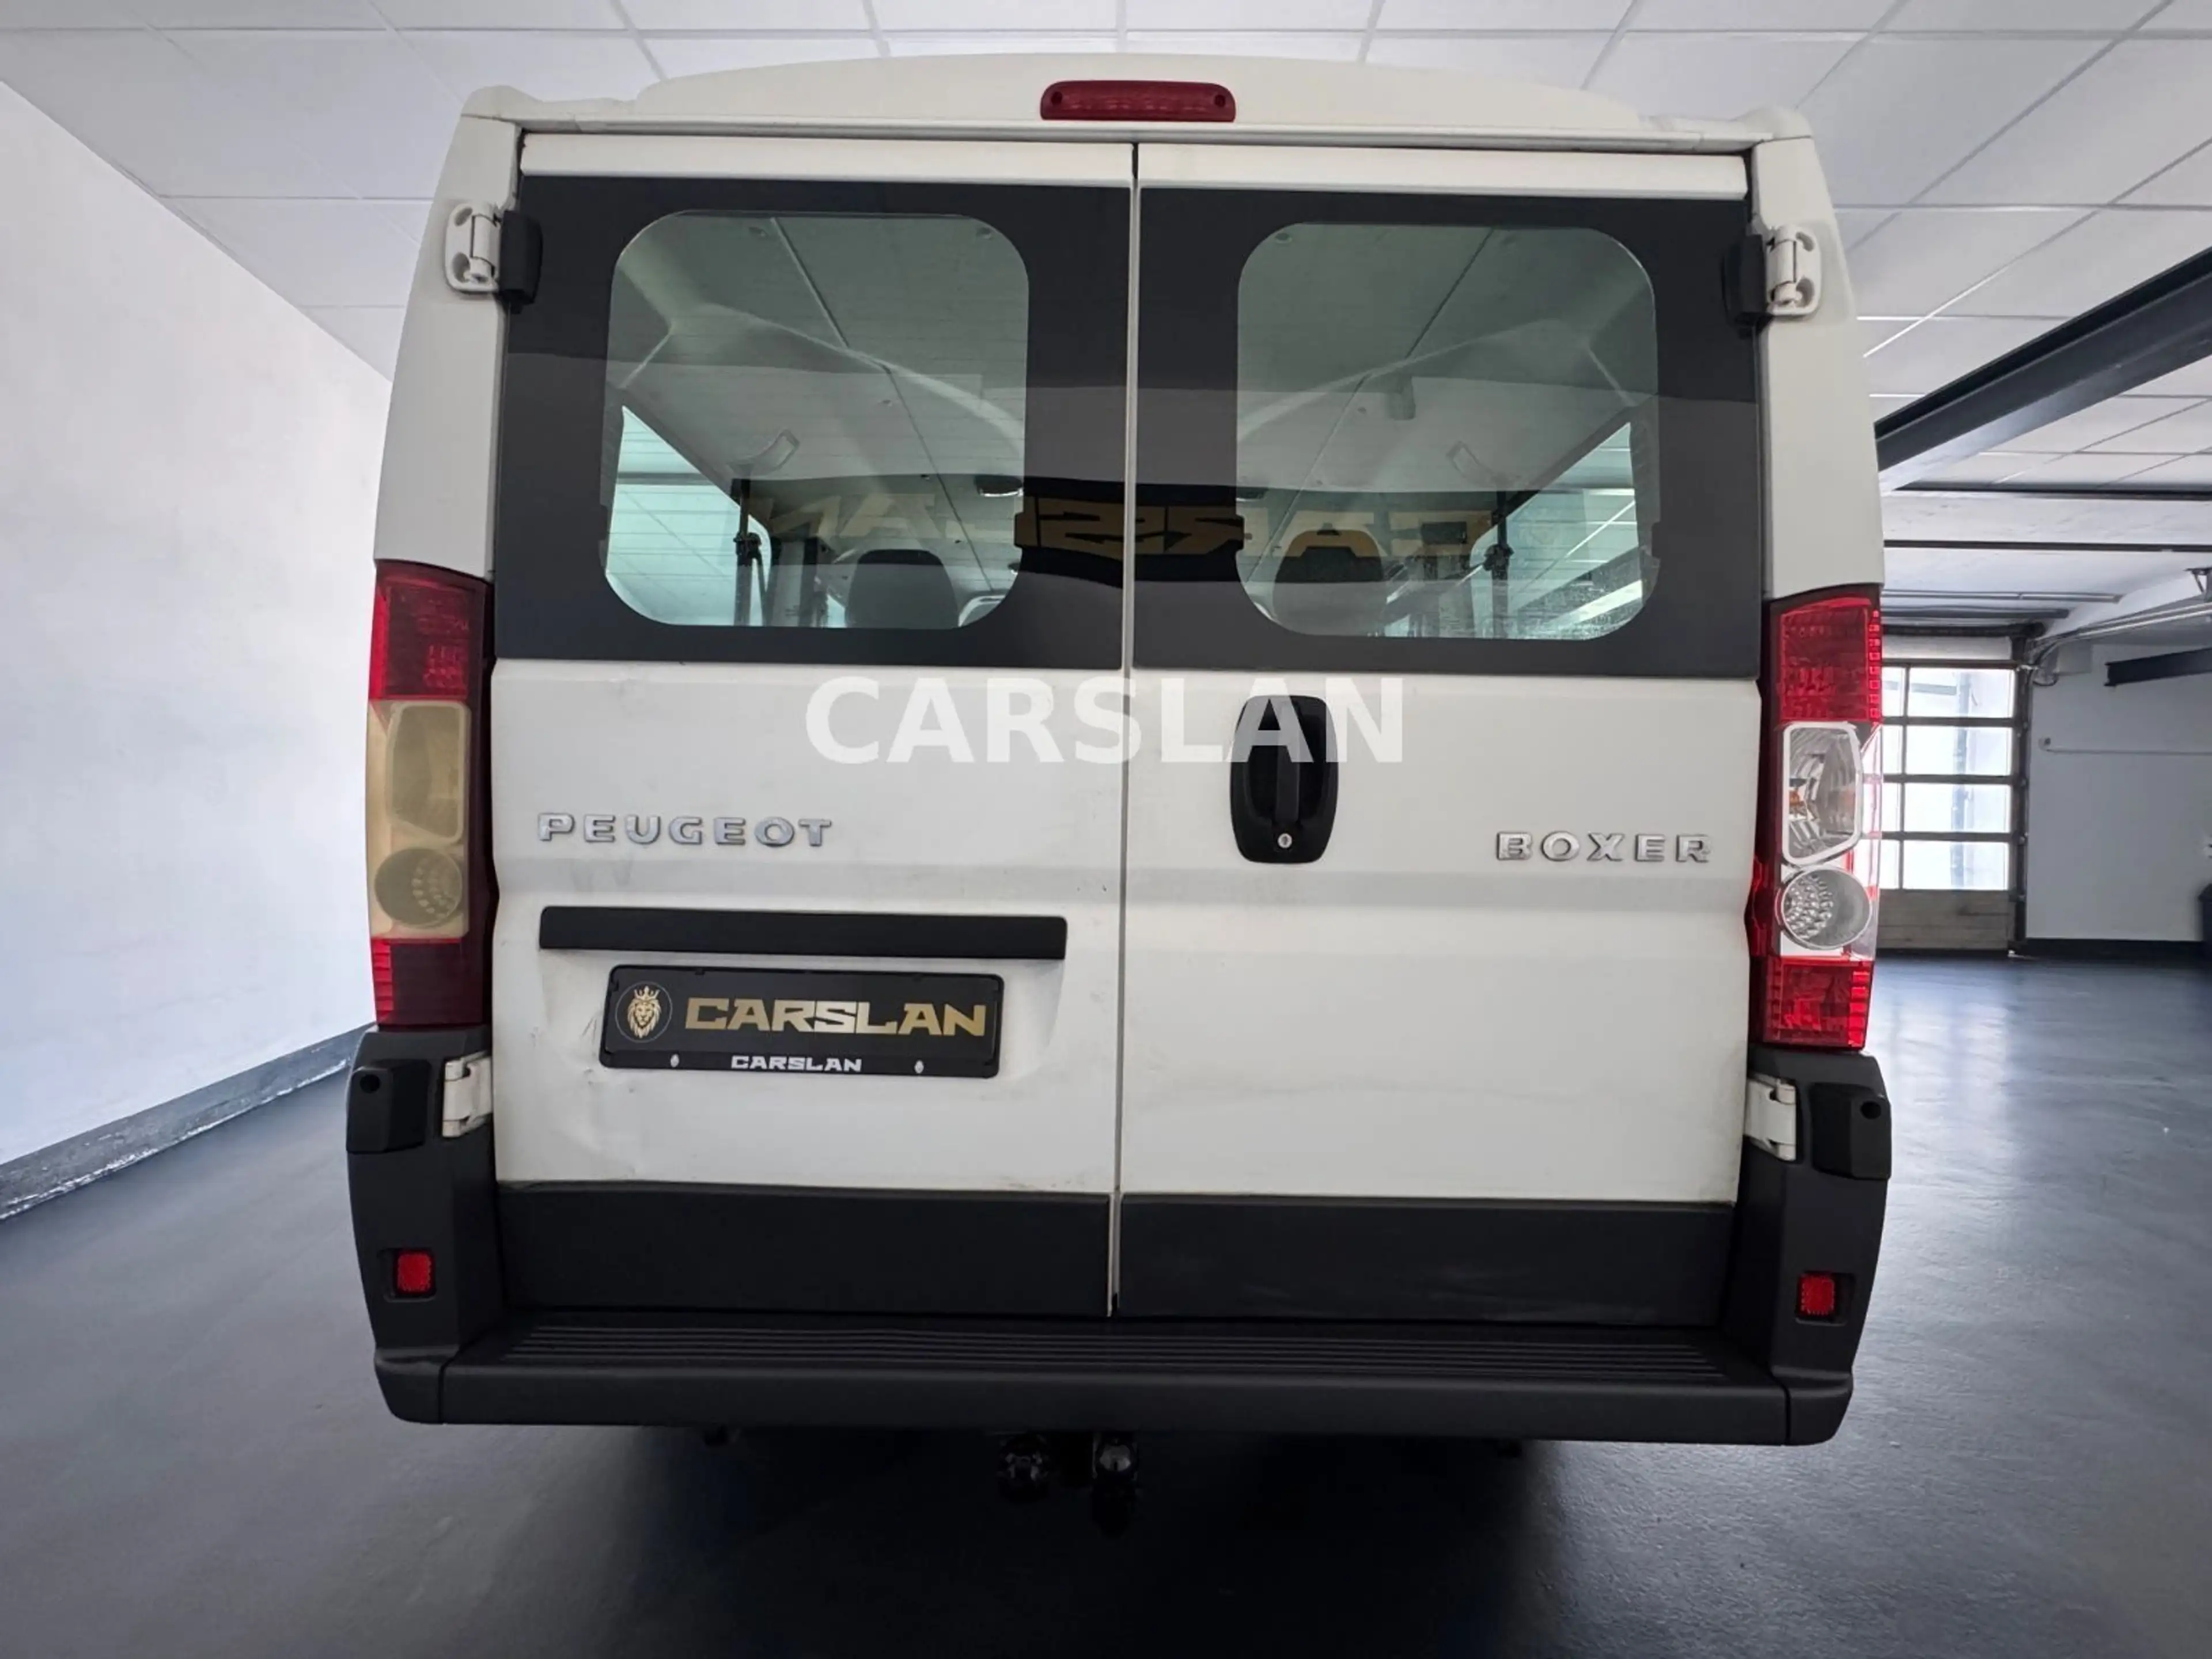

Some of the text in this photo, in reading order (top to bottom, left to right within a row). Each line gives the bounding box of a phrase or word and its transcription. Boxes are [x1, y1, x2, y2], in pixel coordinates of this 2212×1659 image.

[537, 812, 832, 847] PEUGEOT
[1496, 831, 1711, 862] BOXER
[685, 998, 987, 1036] CARSLAN
[730, 1054, 862, 1073] CARSLAN
